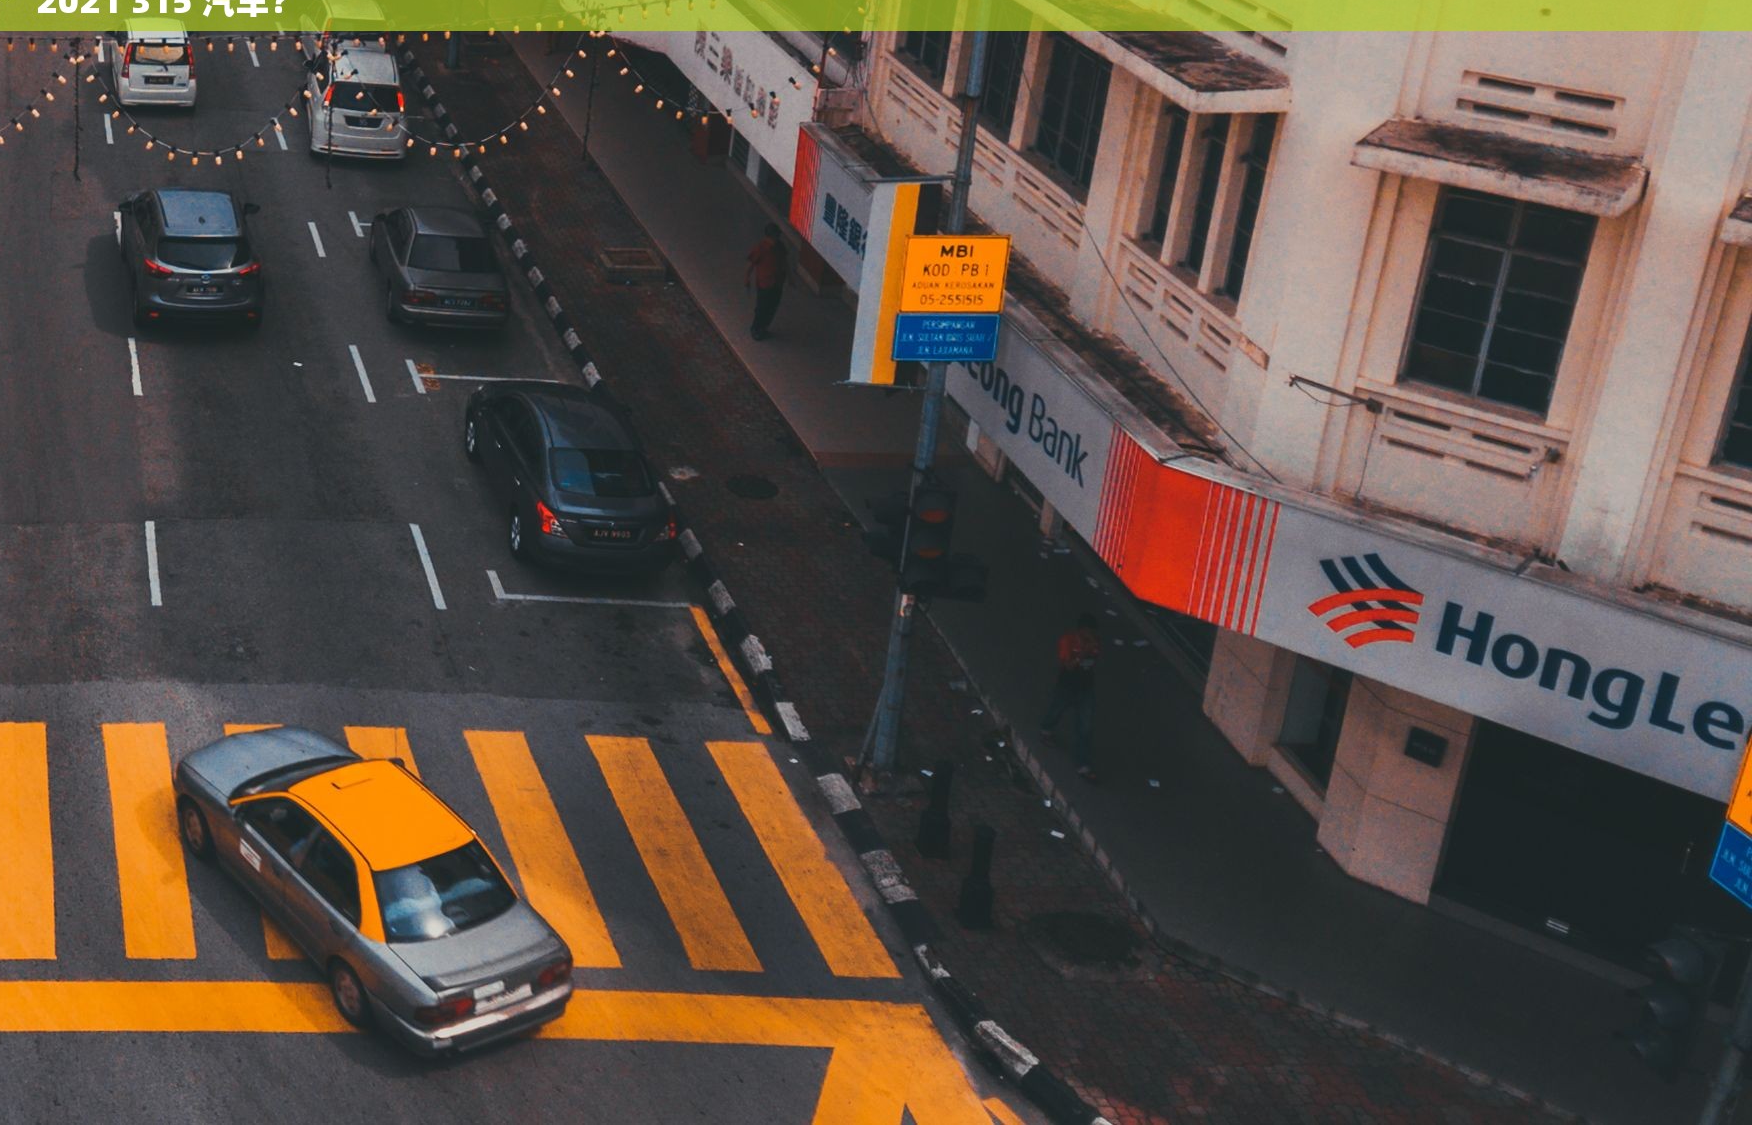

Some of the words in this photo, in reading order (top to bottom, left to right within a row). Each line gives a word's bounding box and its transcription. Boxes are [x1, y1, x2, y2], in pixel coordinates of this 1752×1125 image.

[940, 244, 974, 258] MBI
[922, 263, 950, 277] KOD
[919, 294, 984, 306] 05-2551515
[1028, 393, 1088, 488] Bank
